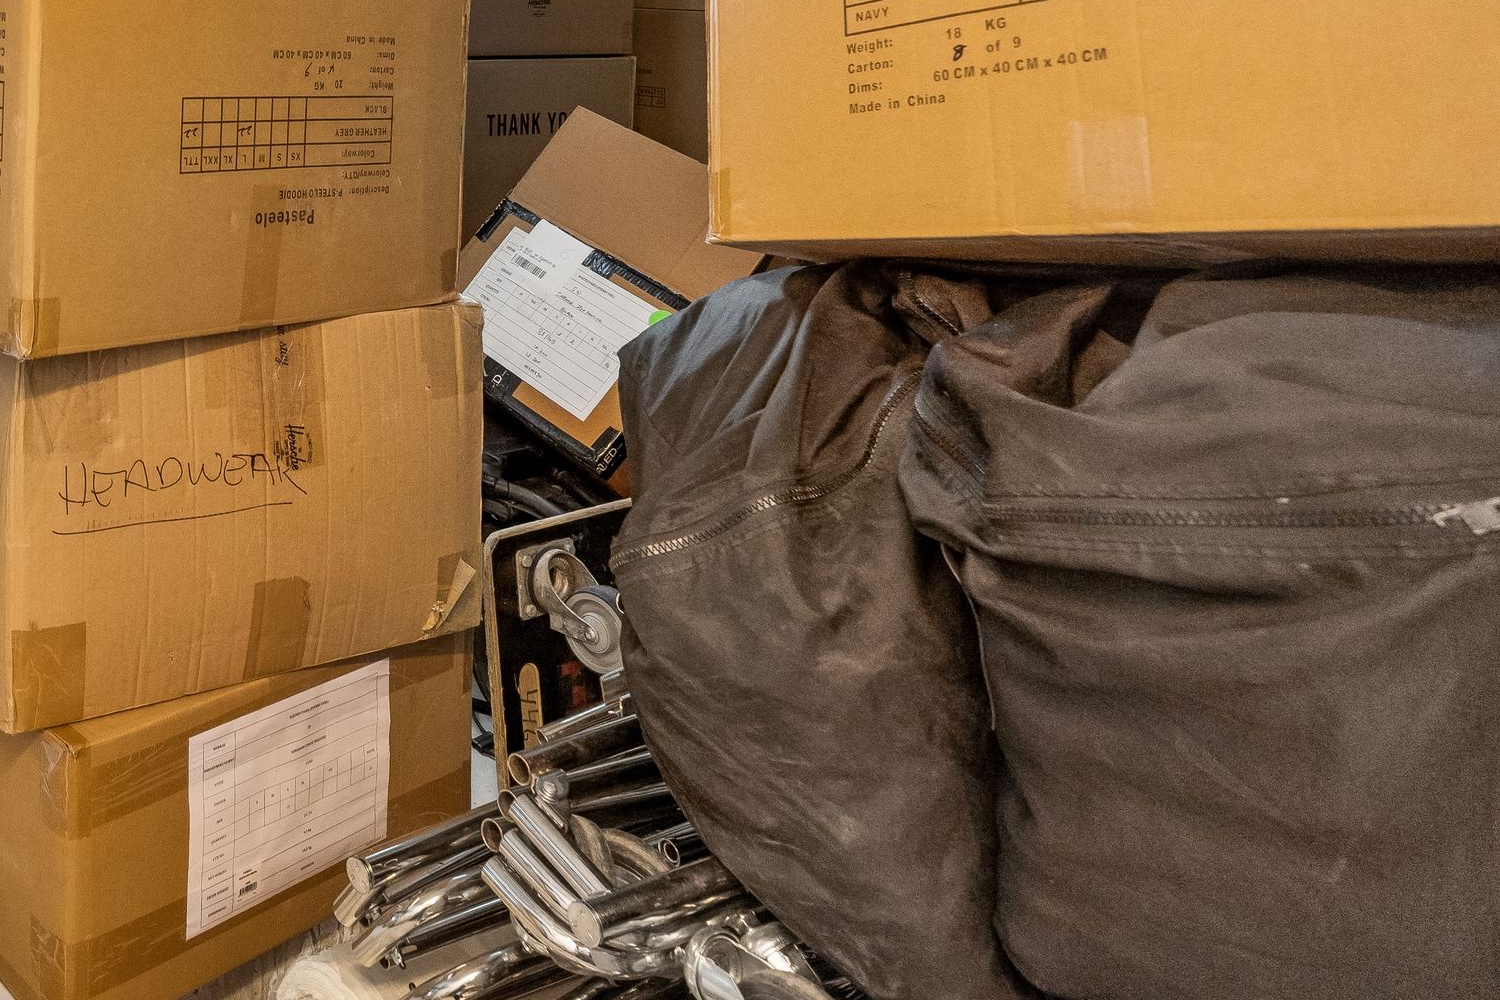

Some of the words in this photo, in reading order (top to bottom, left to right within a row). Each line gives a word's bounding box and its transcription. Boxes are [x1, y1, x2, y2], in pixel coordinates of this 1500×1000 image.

[855, 7, 889, 22] NAVY
[346, 36, 366, 44] China
[847, 38, 893, 55] Weight:
[946, 27, 962, 40] 18
[985, 17, 1007, 31] KG
[379, 37, 396, 45] Made
[273, 50, 285, 59] CM
[286, 50, 295, 59] 40
[302, 50, 314, 59] CM
[315, 51, 324, 59] 40
[331, 51, 342, 60] CM
[343, 51, 352, 60] 60
[376, 51, 395, 60] Dims:
[847, 59, 894, 74] Carton:
[986, 40, 1001, 53] of
[1012, 36, 1022, 49] 9
[318, 65, 326, 75] of
[369, 66, 395, 75] Carton:
[848, 80, 882, 94] Dims:
[933, 69, 950, 82] 60
[953, 66, 975, 79] CM
[980, 67, 988, 77] x
[992, 61, 1010, 74] 40
[1015, 57, 1039, 71] CM
[1043, 57, 1053, 67] x
[1057, 52, 1077, 65] 40
[1082, 47, 1108, 62] CM
[314, 81, 325, 90] KG
[335, 80, 343, 89] 20
[369, 80, 394, 90] Weight:
[849, 102, 882, 114] Made
[888, 99, 900, 109] in
[907, 92, 946, 107] China
[364, 105, 387, 114] BLACK
[486, 113, 541, 136] THANK
[548, 111, 568, 134] YO
[335, 129, 354, 137] GREY
[355, 127, 387, 136] HEATHER
[259, 154, 265, 162] M
[277, 153, 282, 161] S
[291, 152, 301, 161] XS
[341, 149, 375, 158] Colorway:
[184, 156, 199, 165] TTL
[204, 156, 219, 165] XXL
[223, 155, 233, 164] XL
[242, 155, 247, 163] L
[279, 189, 307, 200] HOODIE
[309, 188, 343, 198] P-STEELO
[349, 185, 390, 195] Description:
[255, 209, 315, 228] Pasteelo
[59, 452, 307, 515] HEADWEAR
